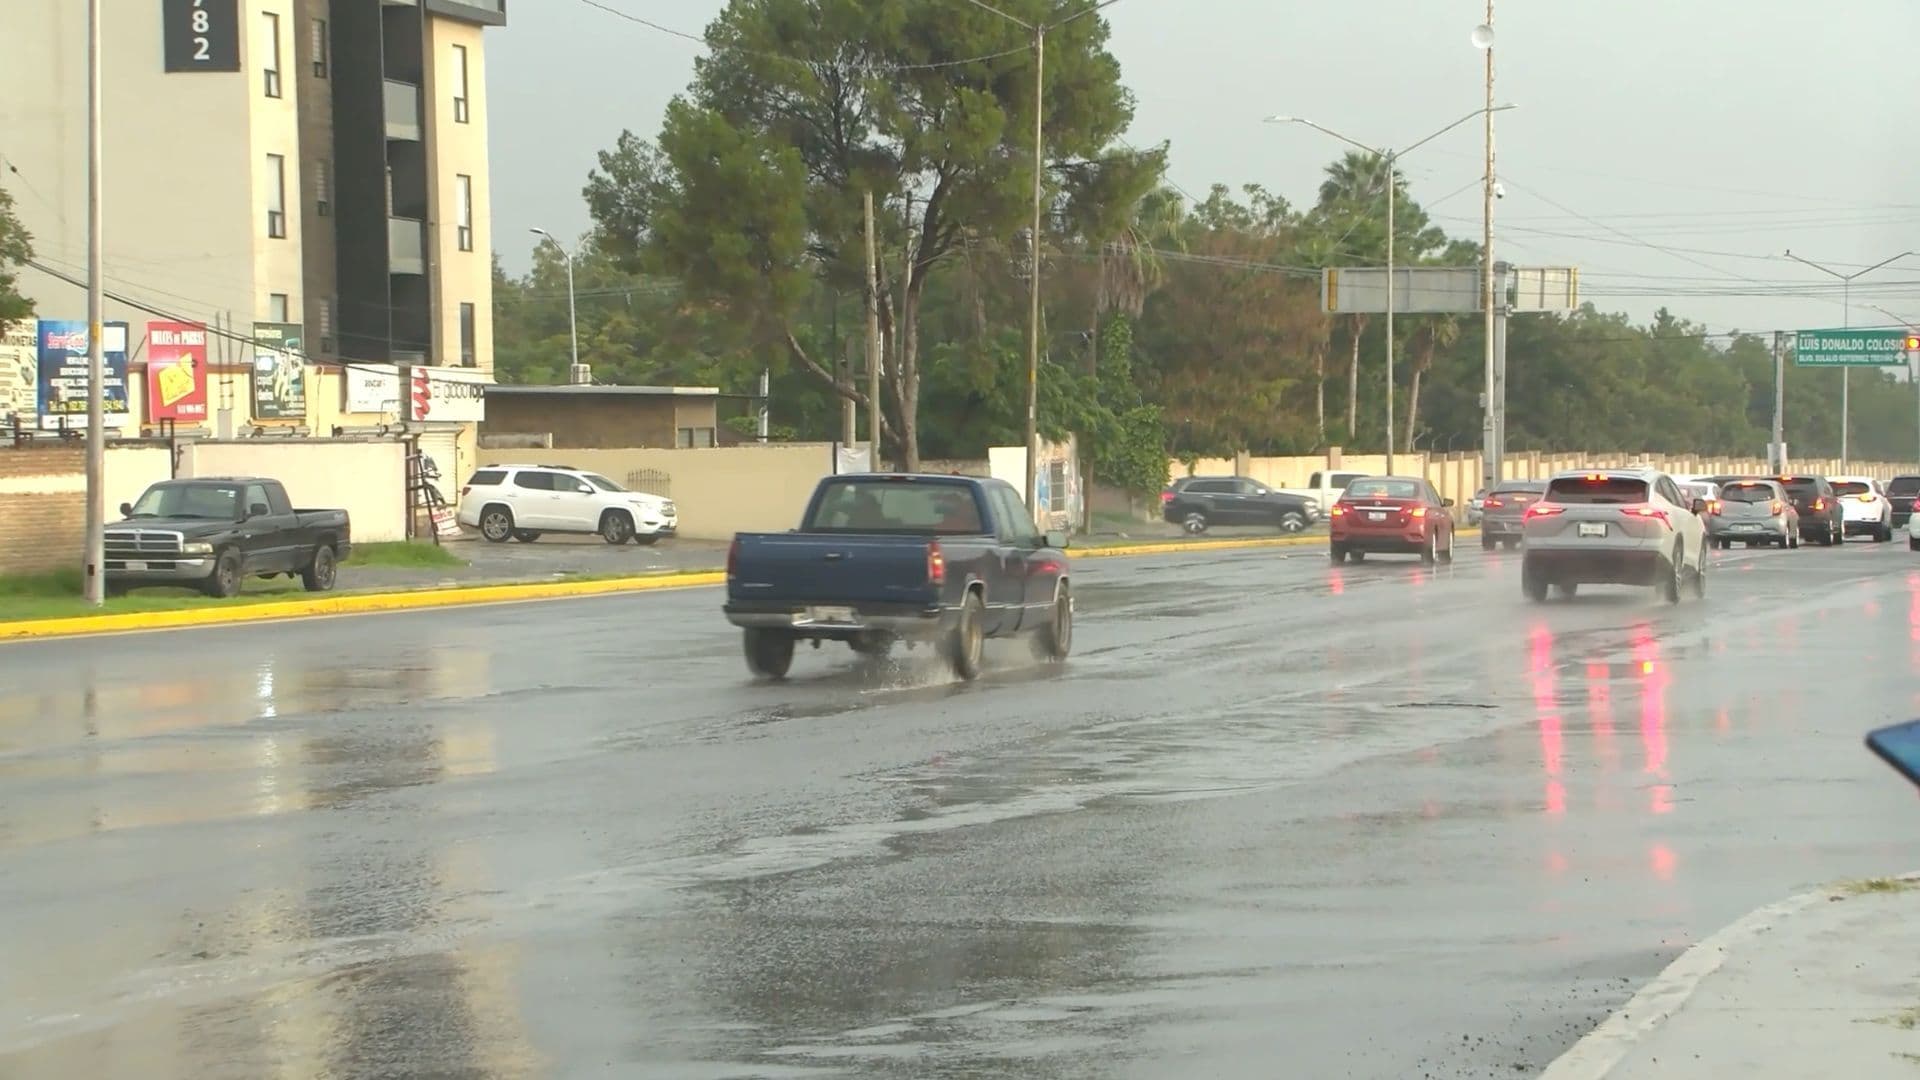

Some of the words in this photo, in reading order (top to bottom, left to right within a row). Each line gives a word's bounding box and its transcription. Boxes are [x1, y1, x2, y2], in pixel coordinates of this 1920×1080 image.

[1800, 339, 1820, 350] LUIS
[1821, 339, 1864, 351] DONALDO
[1866, 339, 1905, 351] COLOSIO
